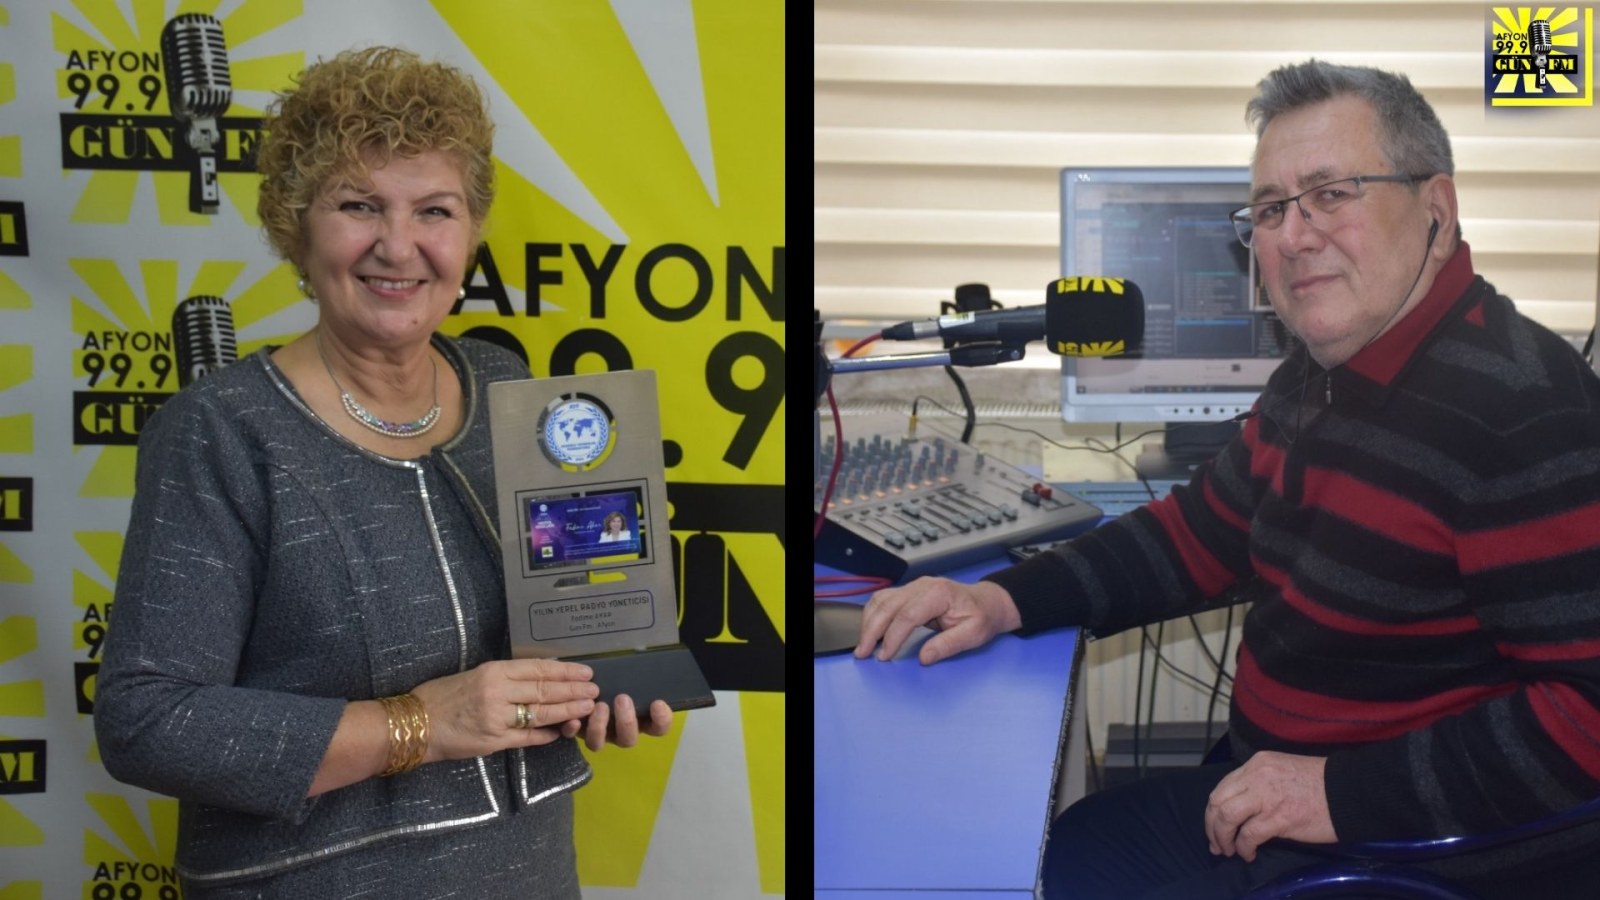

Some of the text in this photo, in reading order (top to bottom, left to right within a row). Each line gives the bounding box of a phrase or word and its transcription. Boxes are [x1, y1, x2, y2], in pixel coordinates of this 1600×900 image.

[66, 50, 160, 72] AFYON
[66, 73, 162, 111] 99.9
[68, 119, 176, 160] GÜN
[448, 241, 786, 323] AFYON
[82, 331, 171, 351] AFYON
[82, 352, 172, 389] 99.9
[80, 396, 163, 435] GÜ
[532, 607, 554, 616] YILIN
[555, 604, 579, 614] YEREL
[580, 601, 607, 611] RADYO
[92, 862, 177, 885] AFYON
